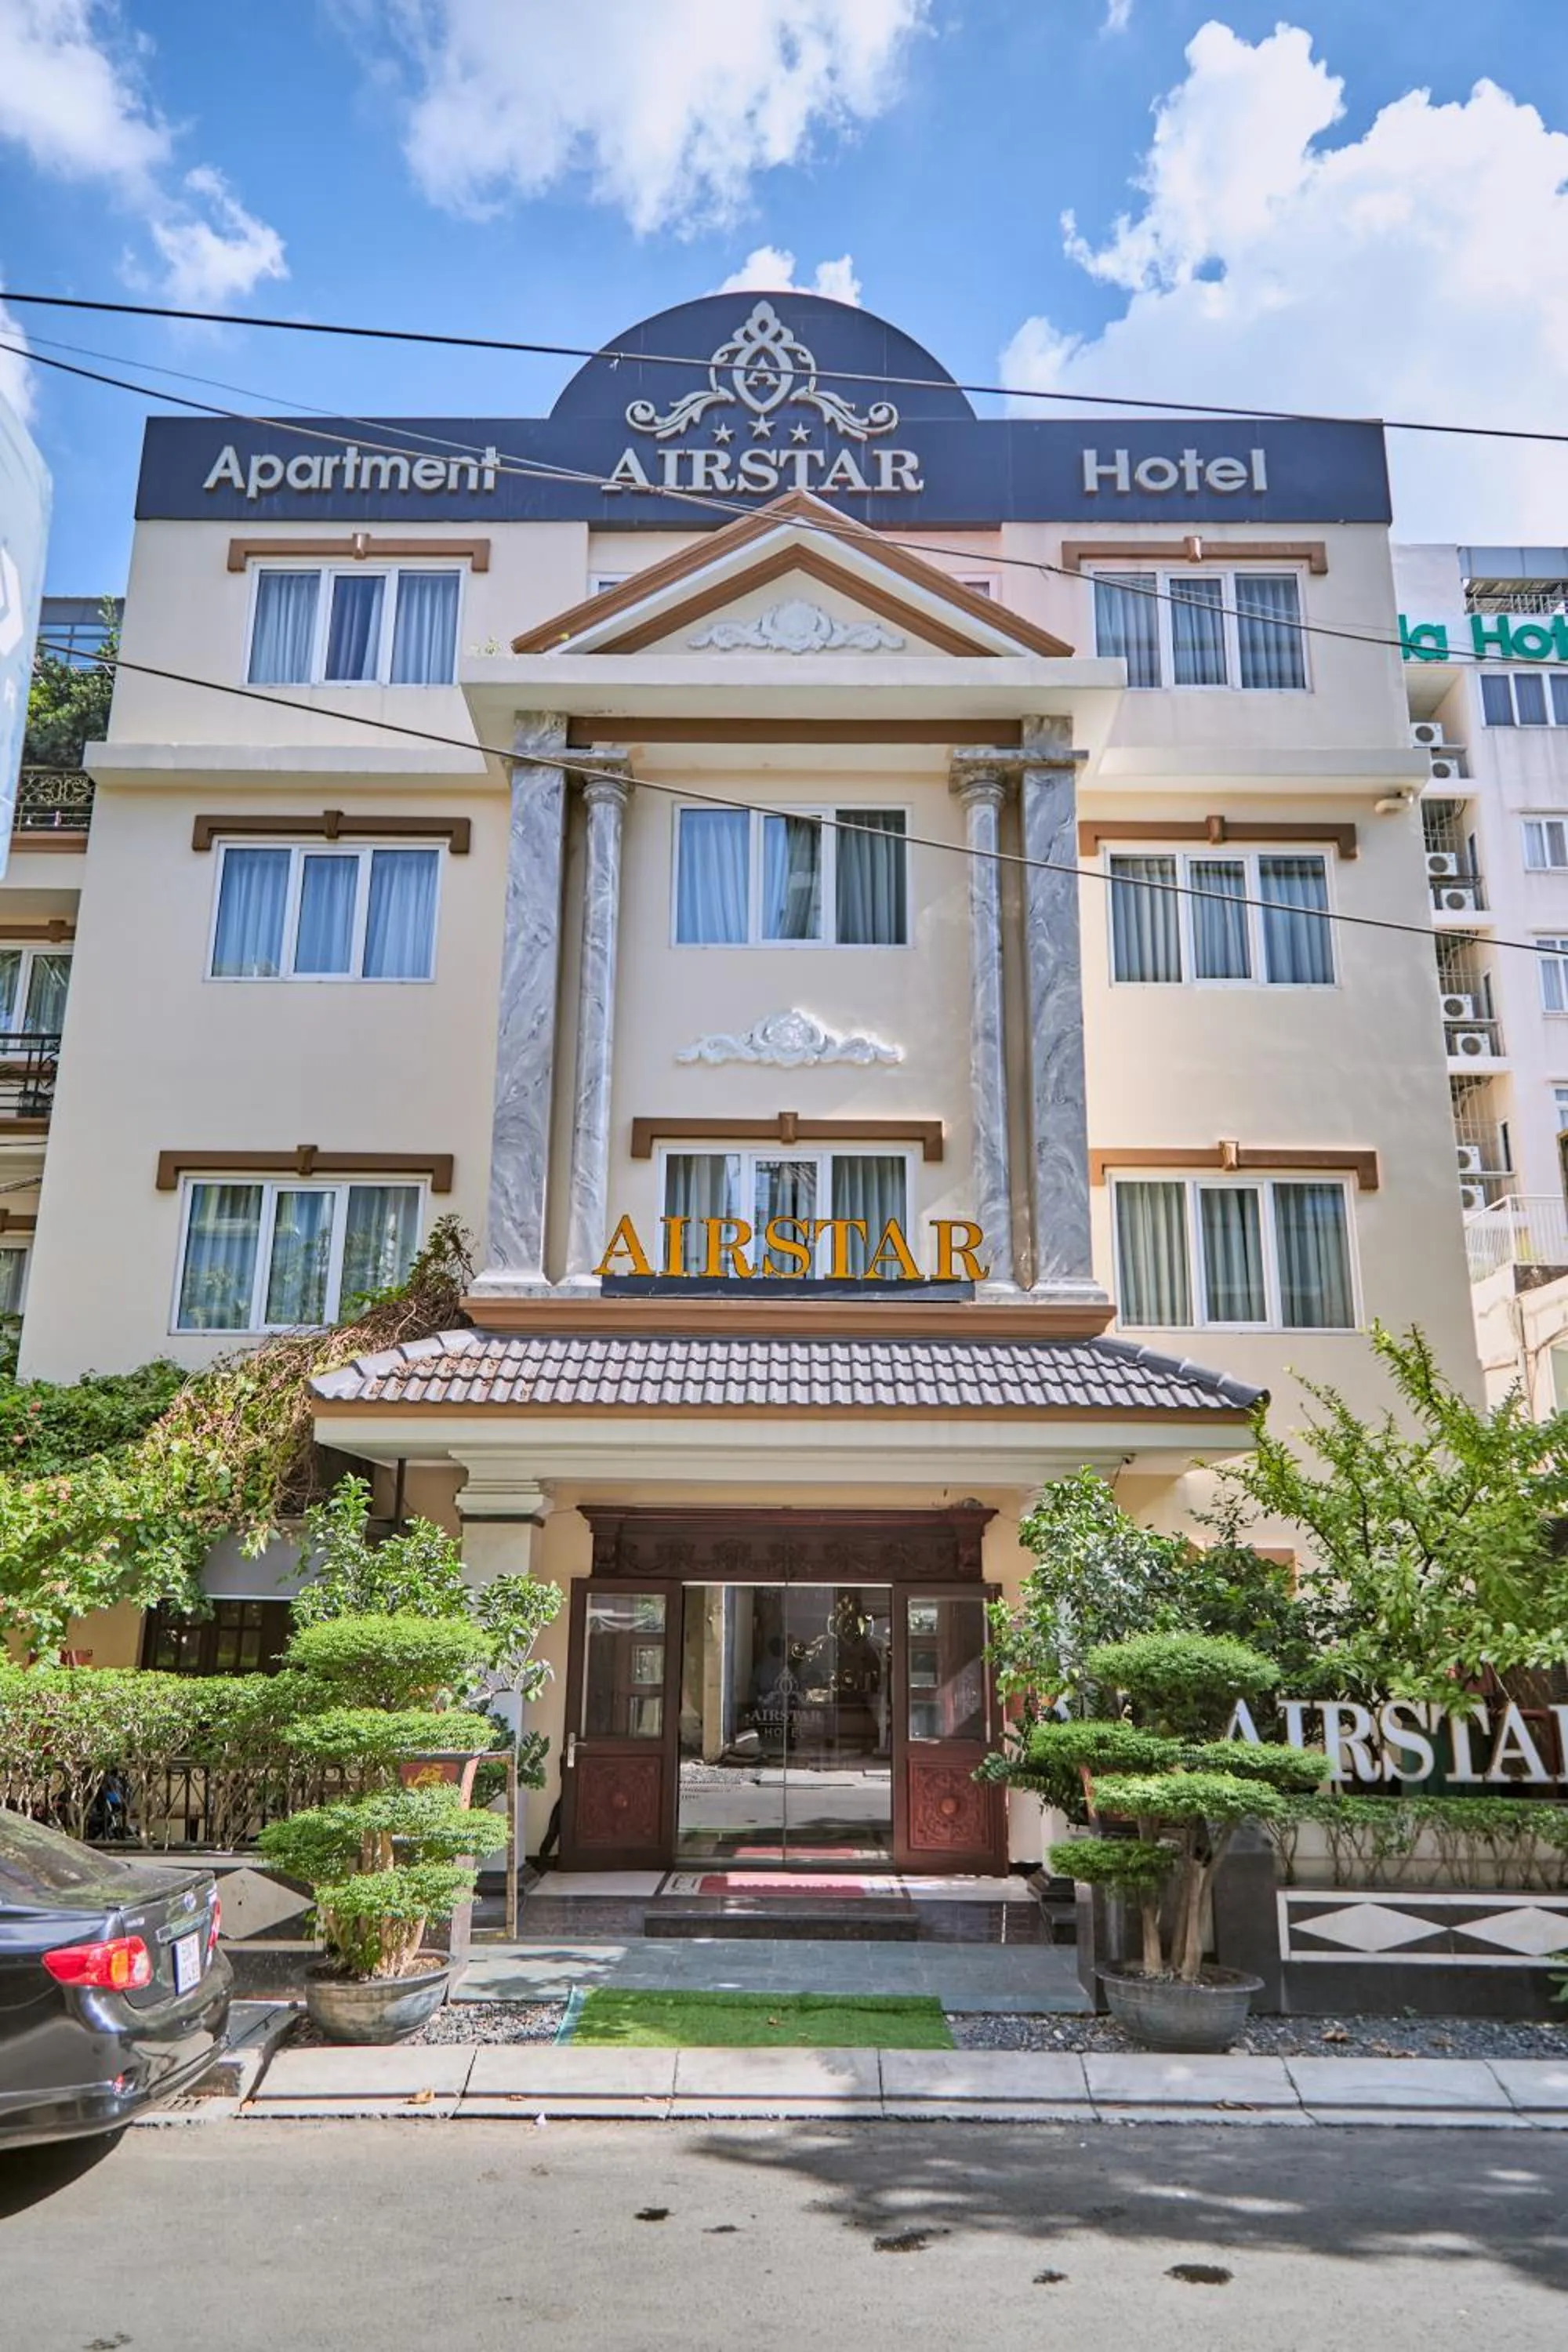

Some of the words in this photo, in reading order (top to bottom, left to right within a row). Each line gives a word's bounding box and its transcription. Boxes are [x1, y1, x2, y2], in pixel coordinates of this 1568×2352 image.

[745, 355, 781, 385] A
[202, 445, 502, 499] Apartment
[601, 447, 925, 493] AIRSTAR
[1081, 448, 1269, 492] Hotel
[591, 1213, 991, 1281] AIRSTAR
[1226, 1697, 1568, 1784] AIRSTA
